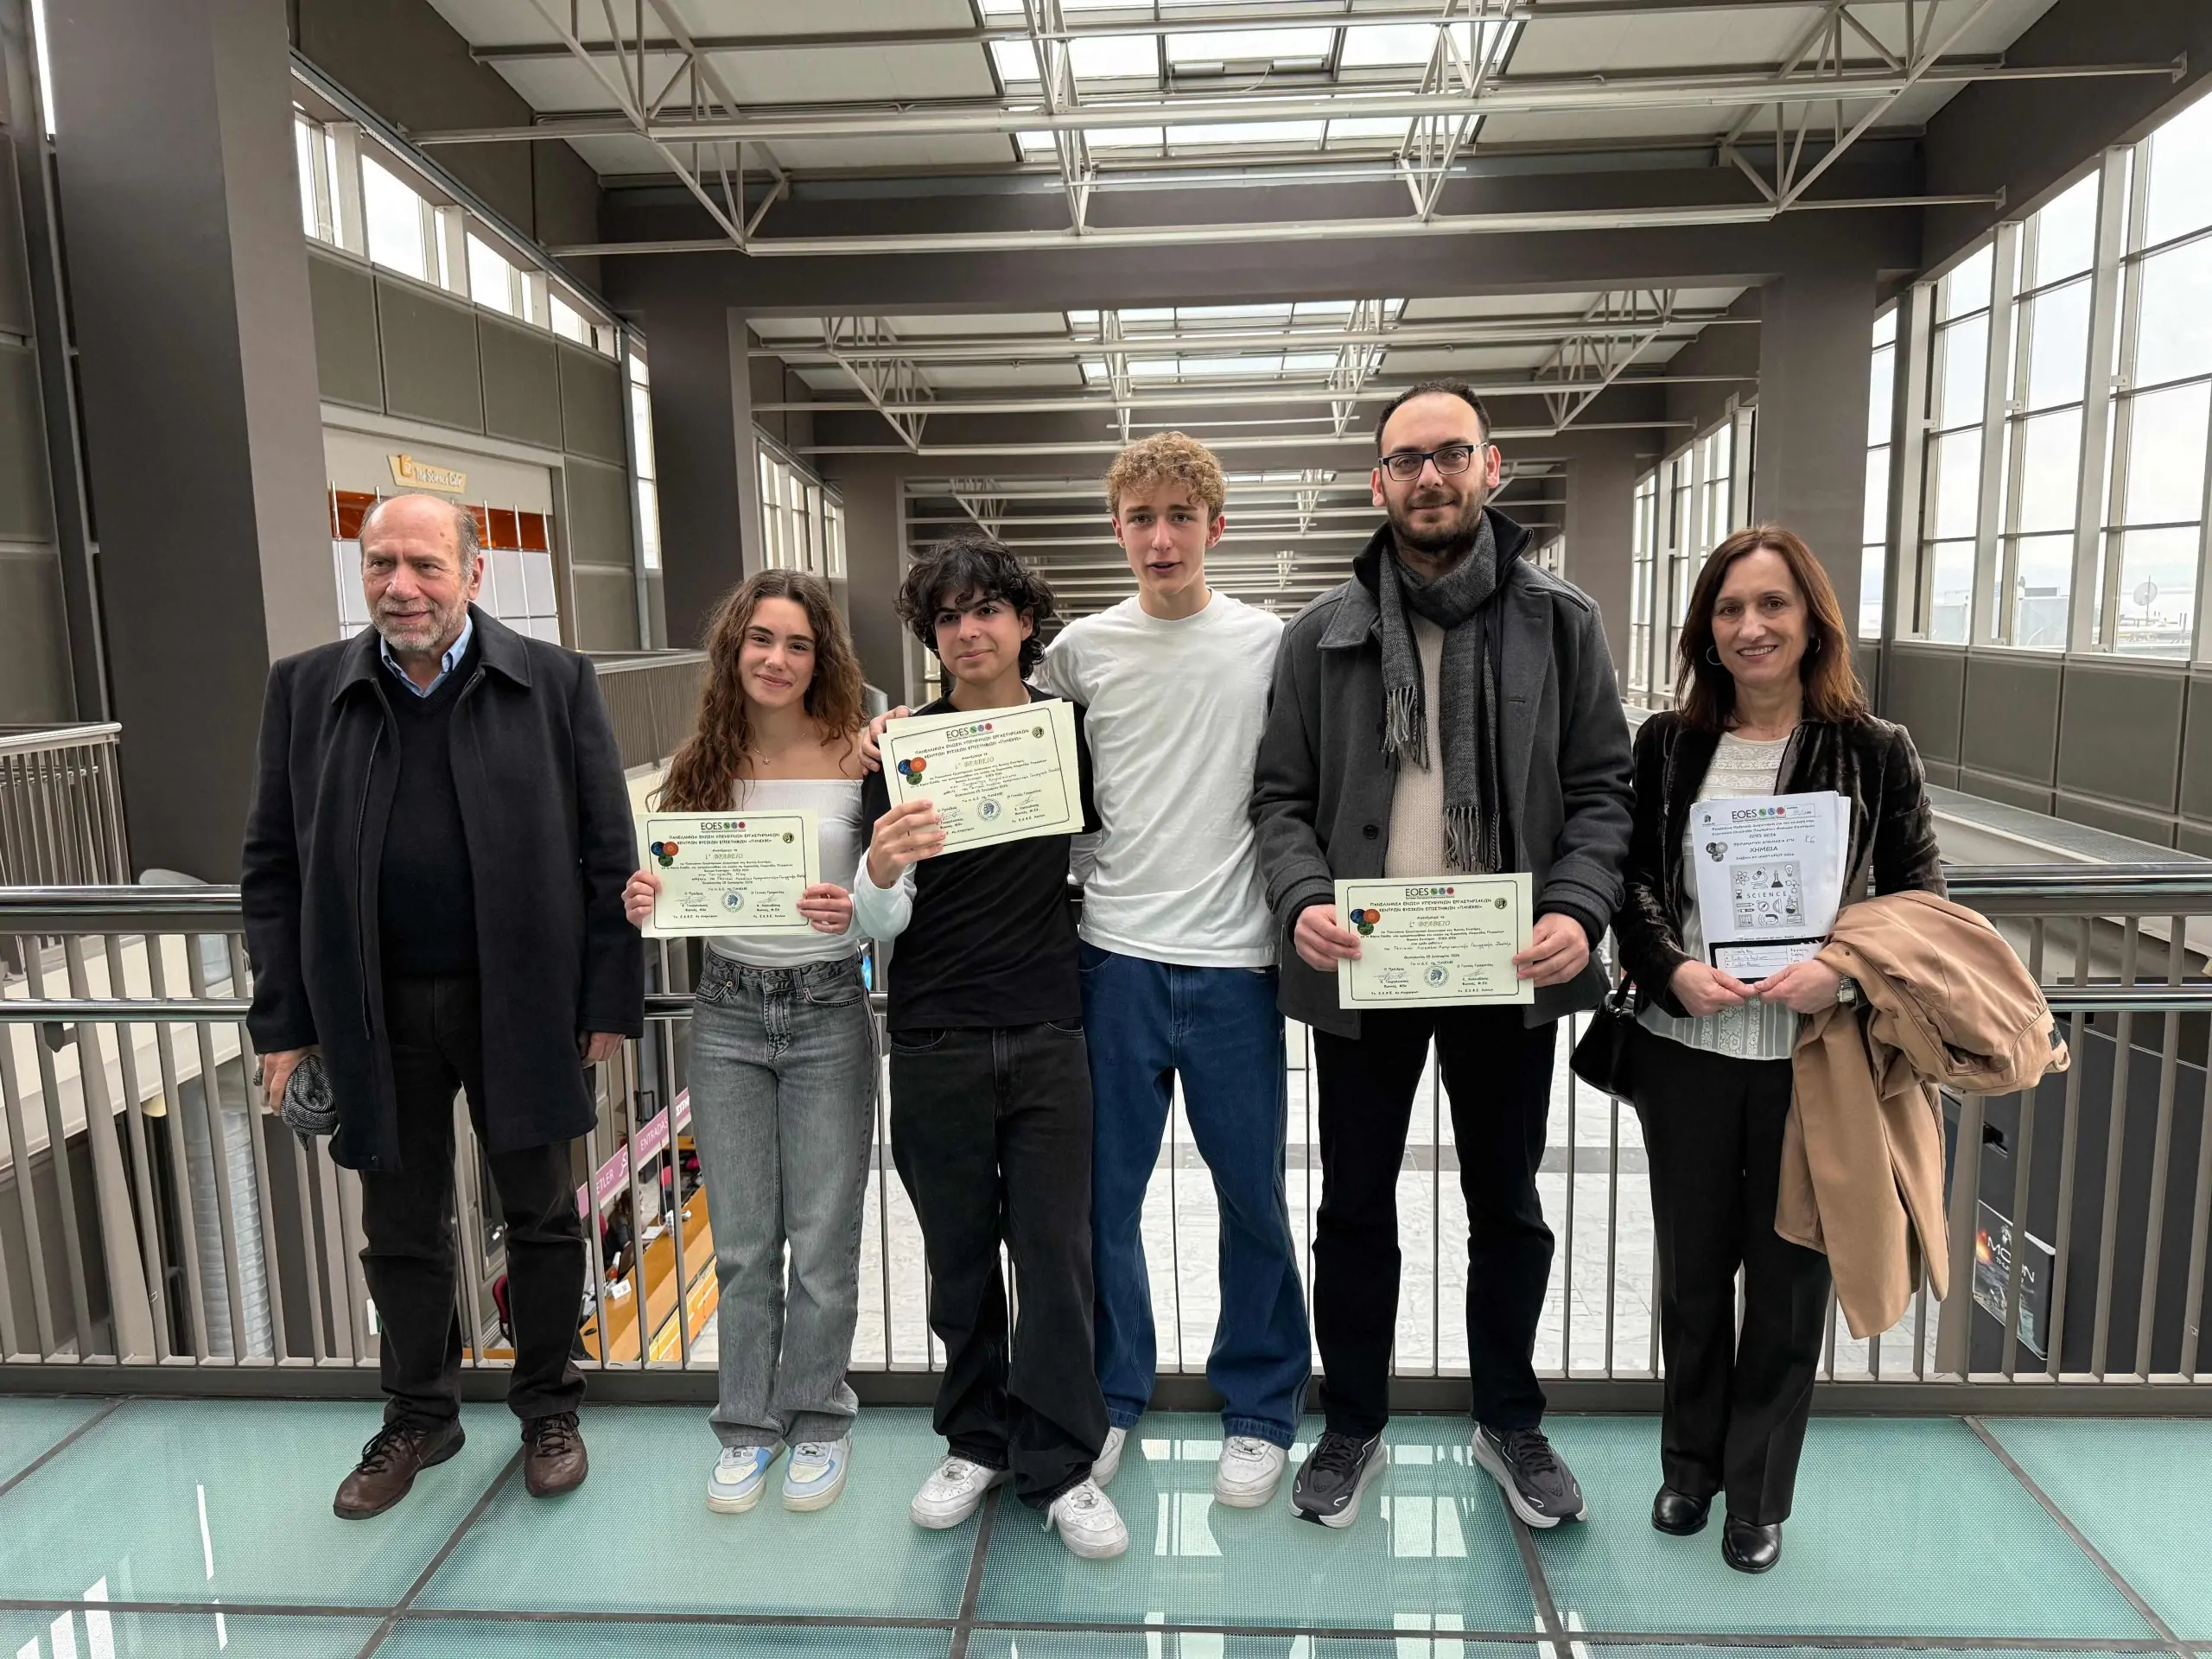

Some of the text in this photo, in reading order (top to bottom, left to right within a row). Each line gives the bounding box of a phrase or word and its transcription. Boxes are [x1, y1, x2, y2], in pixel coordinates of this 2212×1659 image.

[946, 728, 969, 738] EOES
[1732, 809, 1758, 820] EOES
[701, 822, 722, 830] EOES
[1405, 887, 1429, 897] EOES
[640, 1117, 668, 1151] ENTRADAS
[1987, 1236, 2035, 1283] MON
